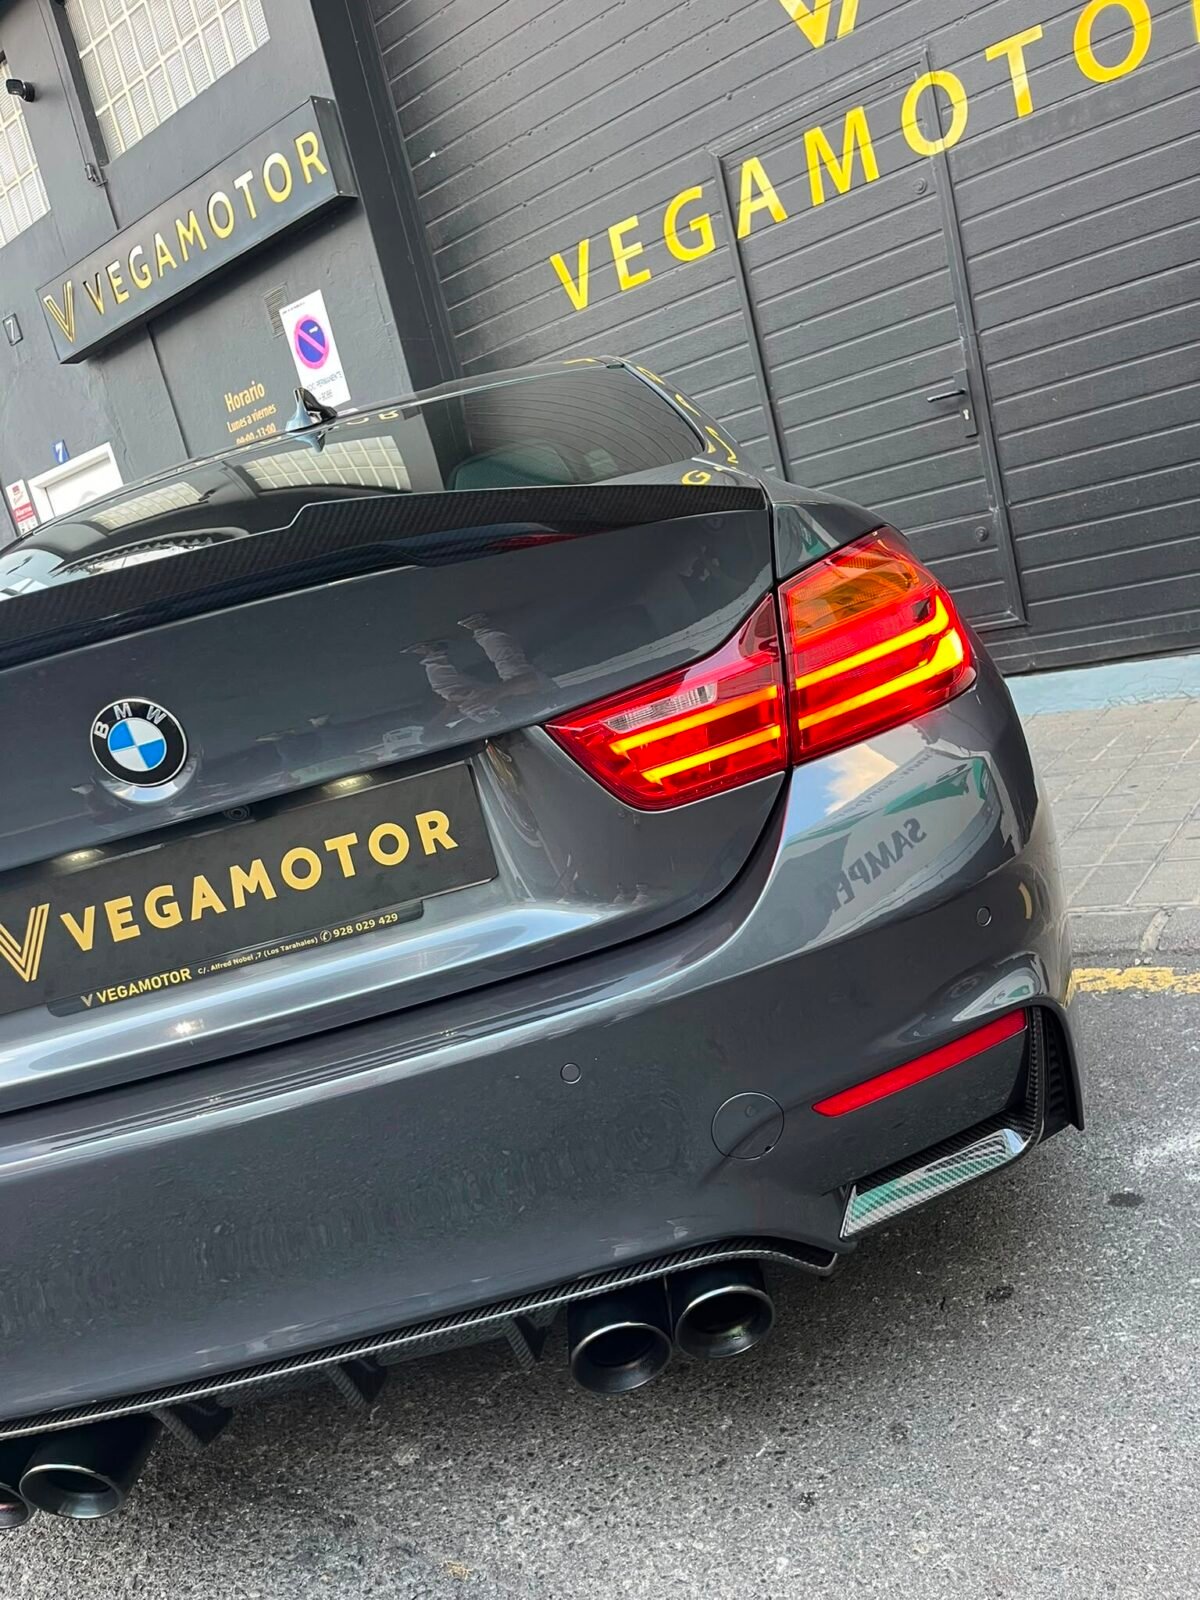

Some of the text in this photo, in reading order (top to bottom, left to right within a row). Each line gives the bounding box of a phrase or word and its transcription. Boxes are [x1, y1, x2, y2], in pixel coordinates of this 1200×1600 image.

[550, 0, 1200, 311] VEGAMOTO
[82, 131, 328, 317] VEGAMOTOR
[224, 380, 265, 413] Horario
[226, 417, 247, 433] Lunes
[251, 404, 276, 422] viernes
[93, 702, 167, 740] BMW
[60, 810, 459, 952] VEGAMOTOR
[96, 967, 193, 1004] VEGAMOTOR
[210, 959, 233, 972] Alfred
[233, 954, 254, 966] Nobel
[263, 947, 280, 959] (Los
[279, 936, 319, 953] Tarahales)
[332, 925, 354, 939] 928
[355, 919, 376, 932] 029
[378, 912, 399, 926] 429
